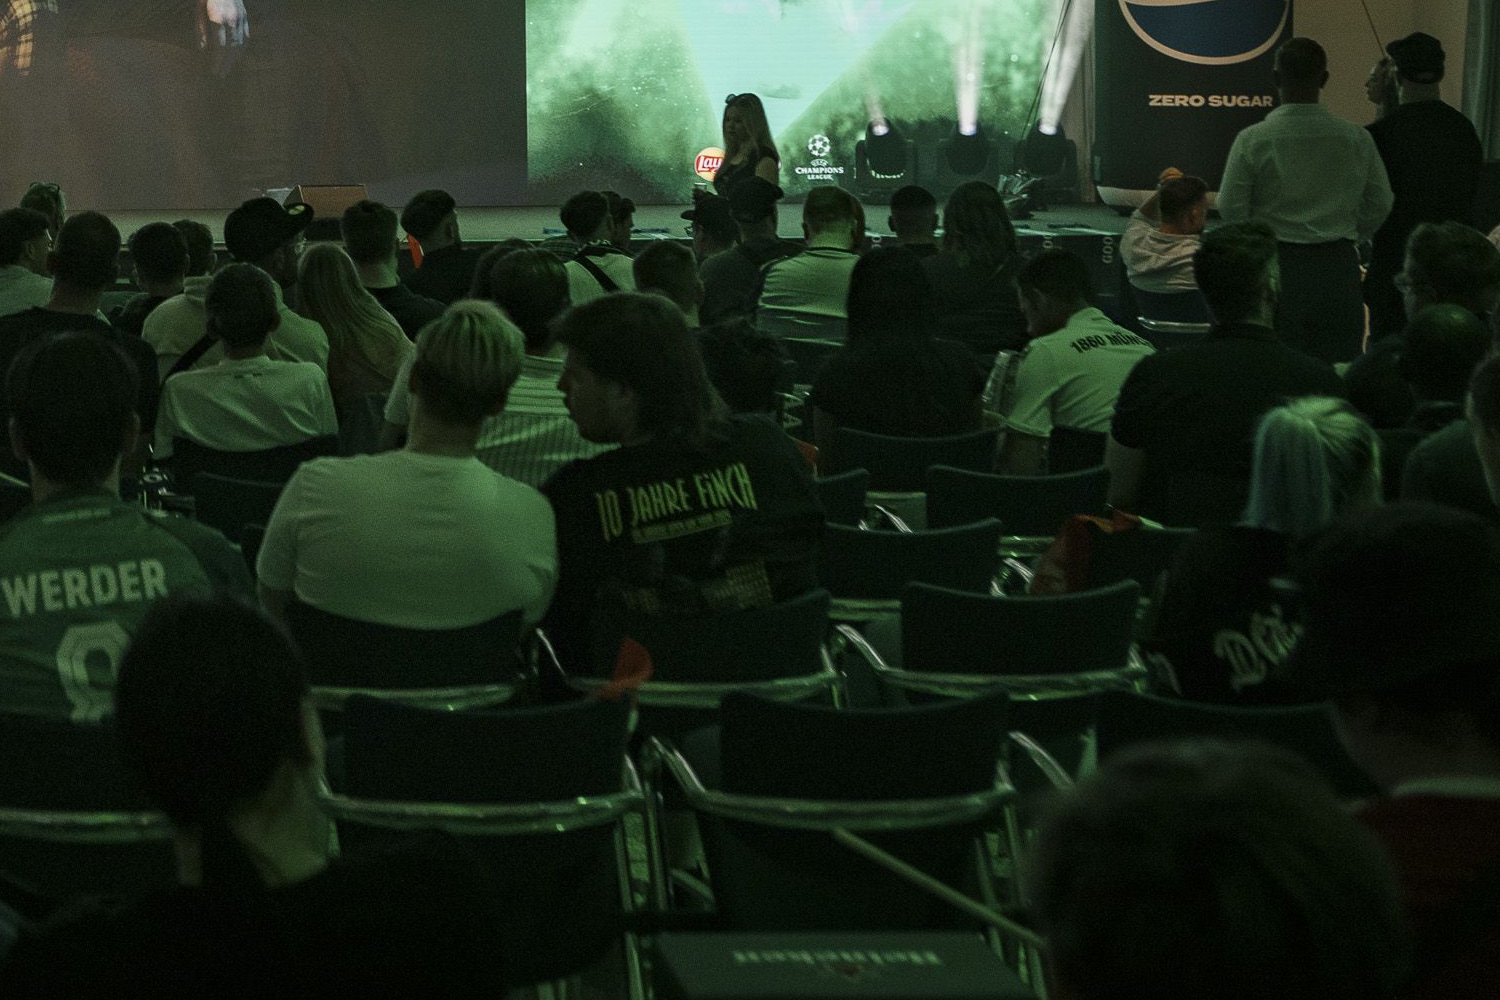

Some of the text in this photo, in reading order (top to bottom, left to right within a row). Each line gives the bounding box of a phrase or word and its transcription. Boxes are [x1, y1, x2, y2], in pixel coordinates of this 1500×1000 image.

[1148, 94, 1274, 107] ZERO SUGAR
[698, 155, 723, 173] Lay
[794, 166, 845, 175] CHAMPIONS
[1070, 334, 1106, 353] 1860
[596, 489, 624, 543] 10
[627, 478, 692, 528] JAHRE
[0, 558, 169, 618] WERDER
